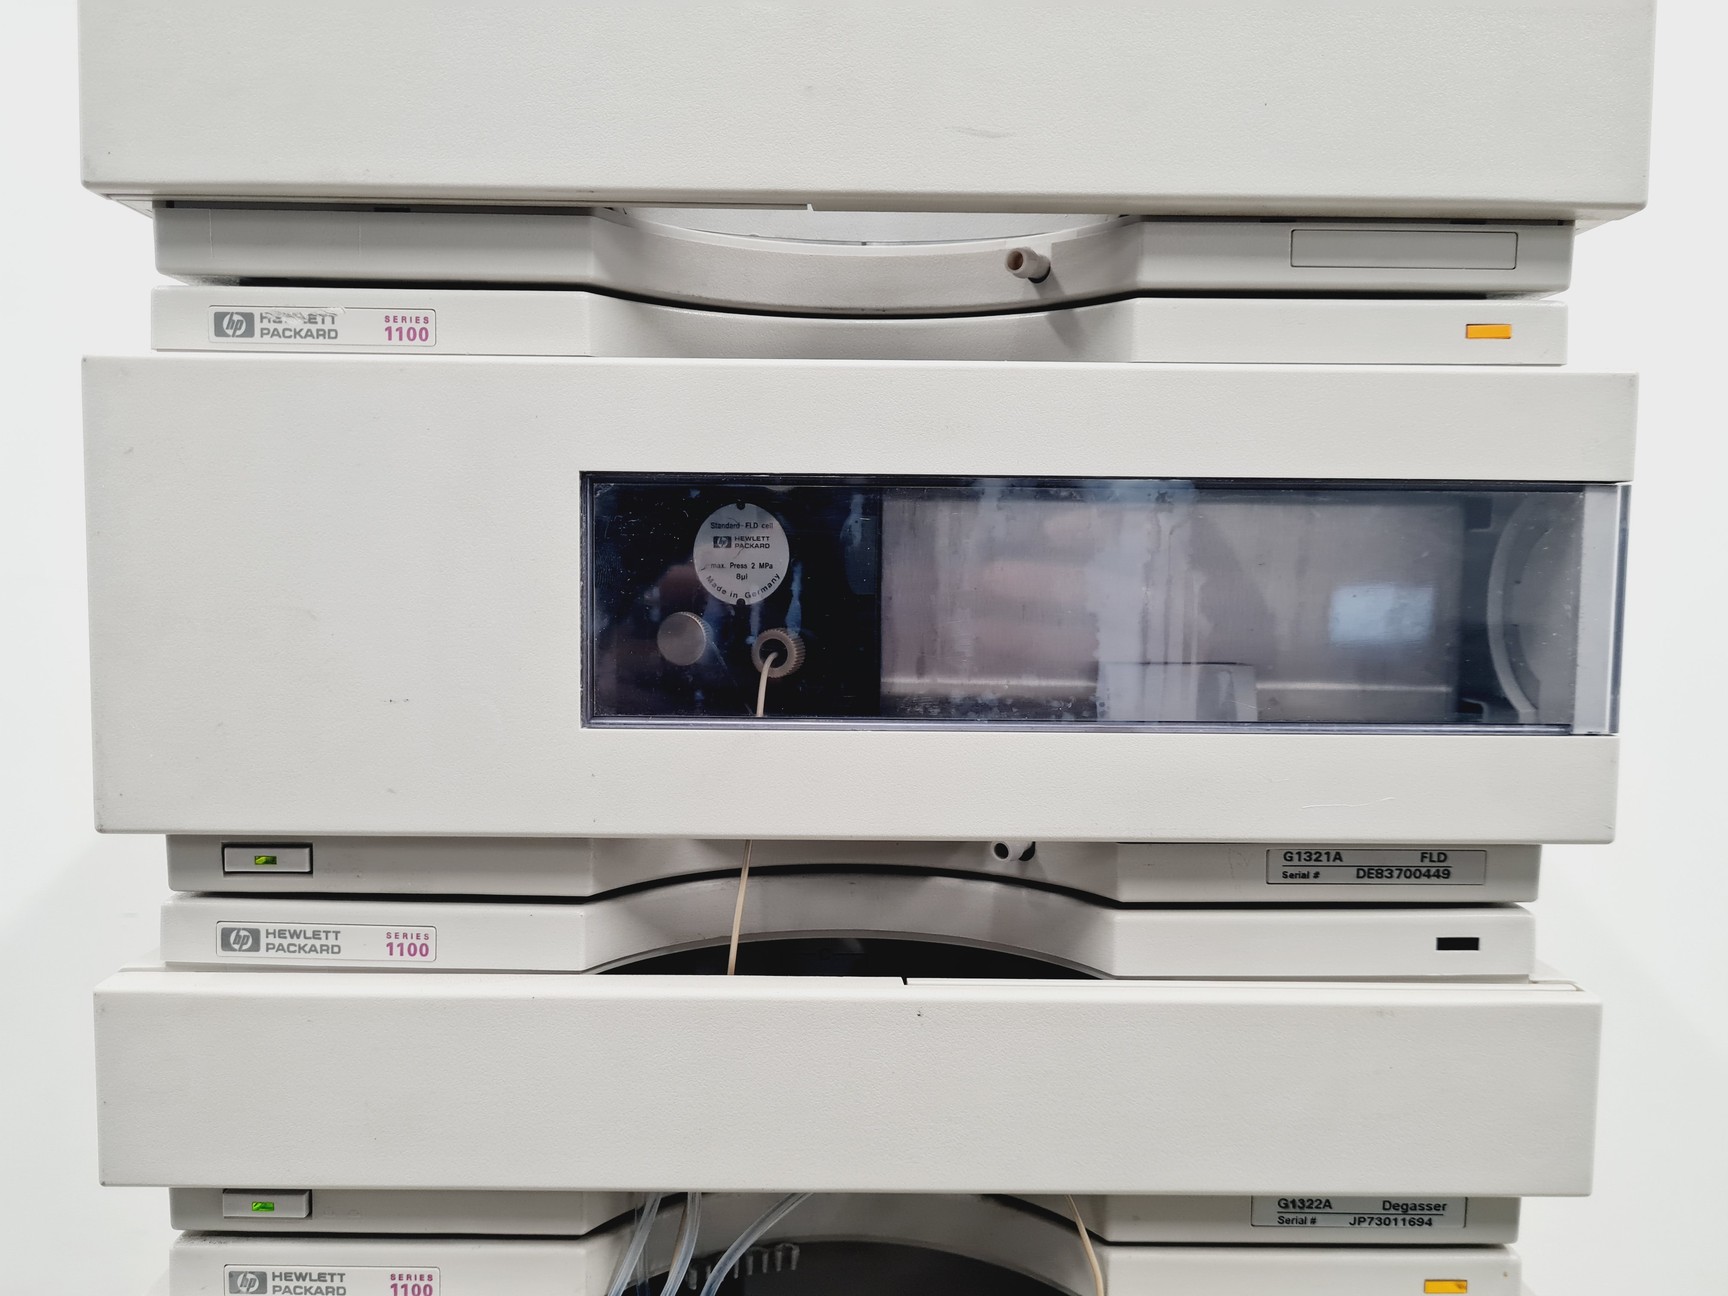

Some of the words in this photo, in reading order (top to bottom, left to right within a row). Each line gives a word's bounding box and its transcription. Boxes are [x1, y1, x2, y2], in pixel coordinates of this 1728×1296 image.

[384, 315, 430, 324] SERIES
[260, 327, 339, 340] PACKARD
[384, 326, 429, 342] 1100
[705, 575, 727, 595] Made
[729, 591, 738, 599] in
[744, 573, 780, 599] Germany
[1283, 851, 1343, 863] G1321A
[1420, 852, 1447, 863] FLD
[1282, 871, 1310, 879] Serial
[1312, 871, 1320, 879] #
[1356, 868, 1450, 880] DE83700449
[265, 929, 341, 941] HEWLETT
[386, 931, 430, 940] SERIES
[265, 943, 341, 954] PACKARD
[386, 942, 429, 957] 1100
[1277, 1198, 1332, 1210] G1322A
[1382, 1200, 1447, 1214] Degasser
[1277, 1216, 1307, 1225] Serial
[1309, 1216, 1317, 1225] #
[1349, 1217, 1433, 1226] JP73011694
[272, 1272, 346, 1283] HEWLETT
[272, 1286, 346, 1296] PACKARD
[390, 1283, 433, 1296] 1100
